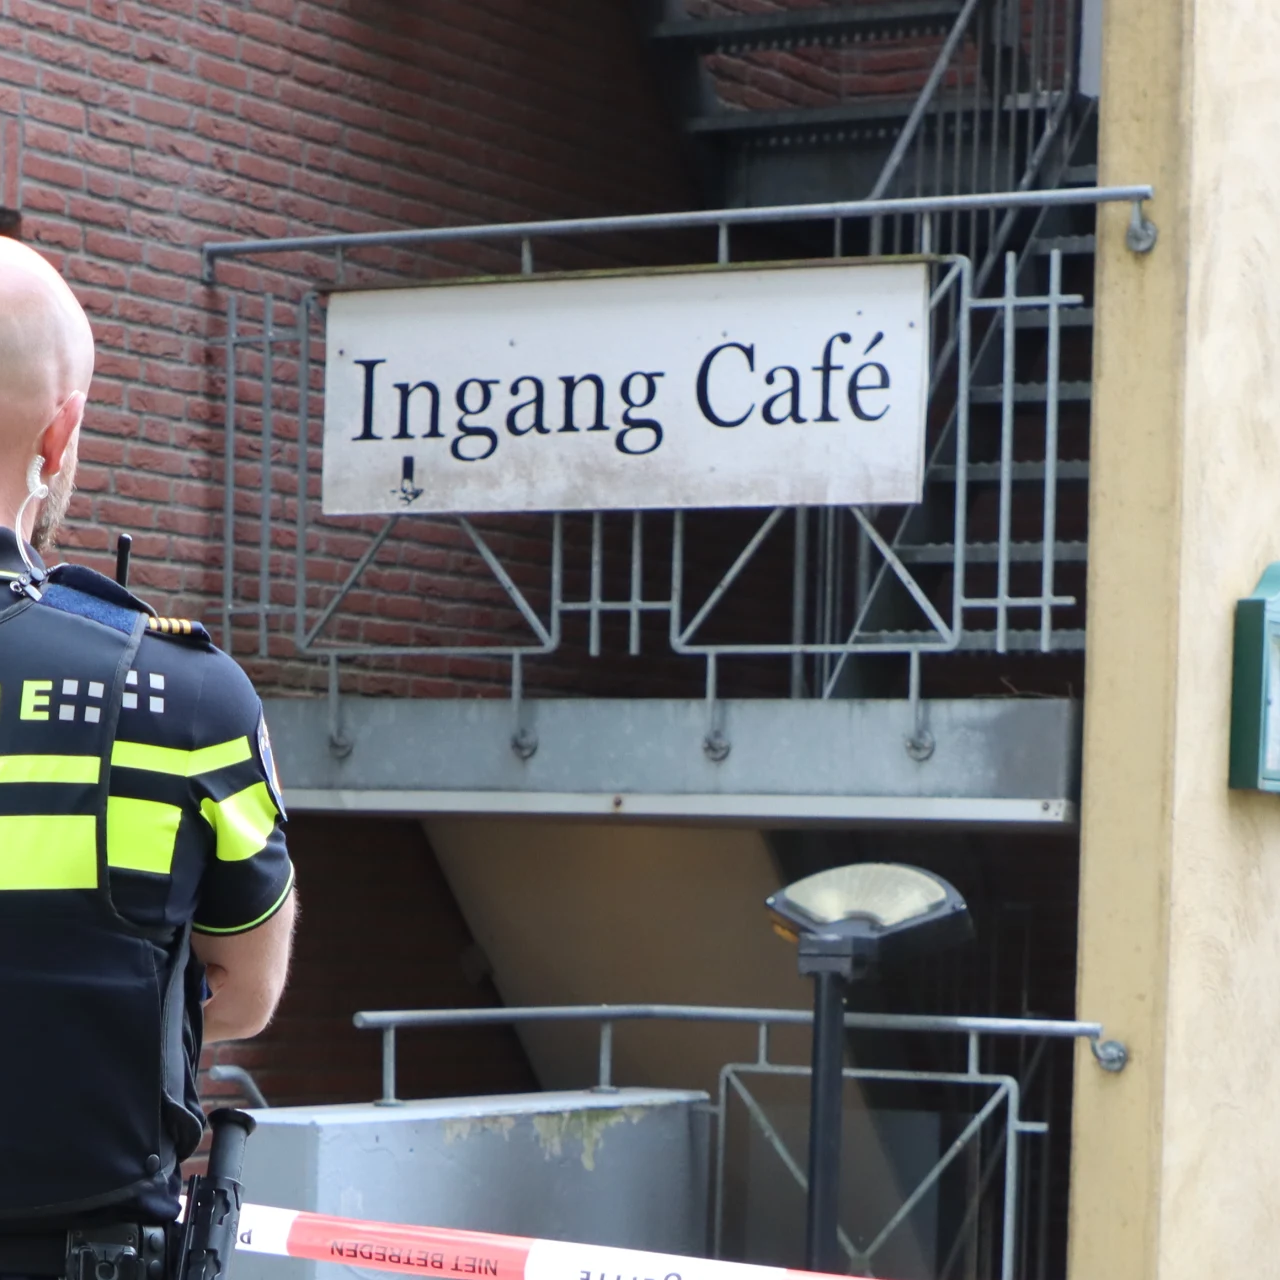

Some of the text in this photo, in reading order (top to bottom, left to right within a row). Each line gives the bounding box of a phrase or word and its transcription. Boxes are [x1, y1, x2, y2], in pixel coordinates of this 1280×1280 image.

[350, 330, 893, 462] Ingang Café
[329, 1239, 498, 1277] NIET BETREDEN
